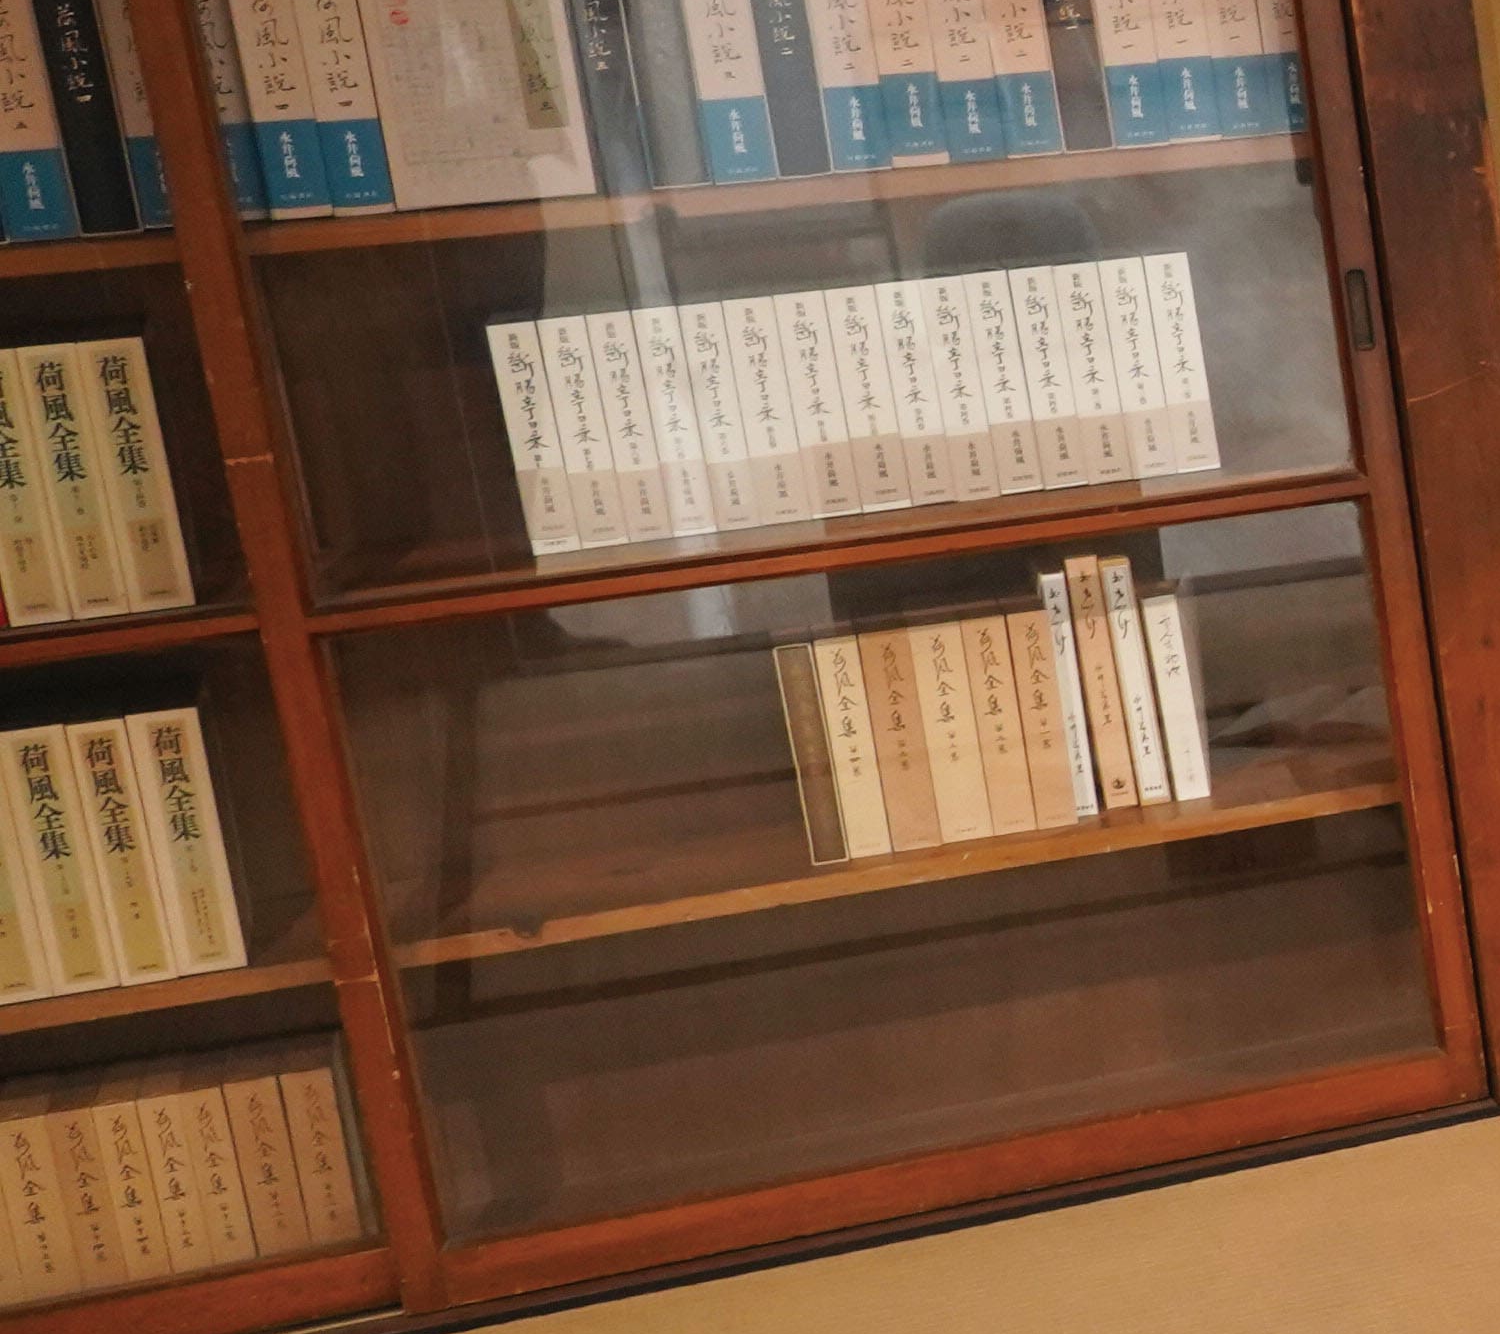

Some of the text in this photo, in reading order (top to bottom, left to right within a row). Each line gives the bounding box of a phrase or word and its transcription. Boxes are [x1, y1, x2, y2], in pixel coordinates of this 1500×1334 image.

[36, 363, 87, 482] 荷風全集
[97, 357, 149, 475] 荷風全集
[19, 743, 71, 861] 荷風全集
[85, 739, 136, 854] 荷風全集
[152, 727, 202, 842] 荷風全集
